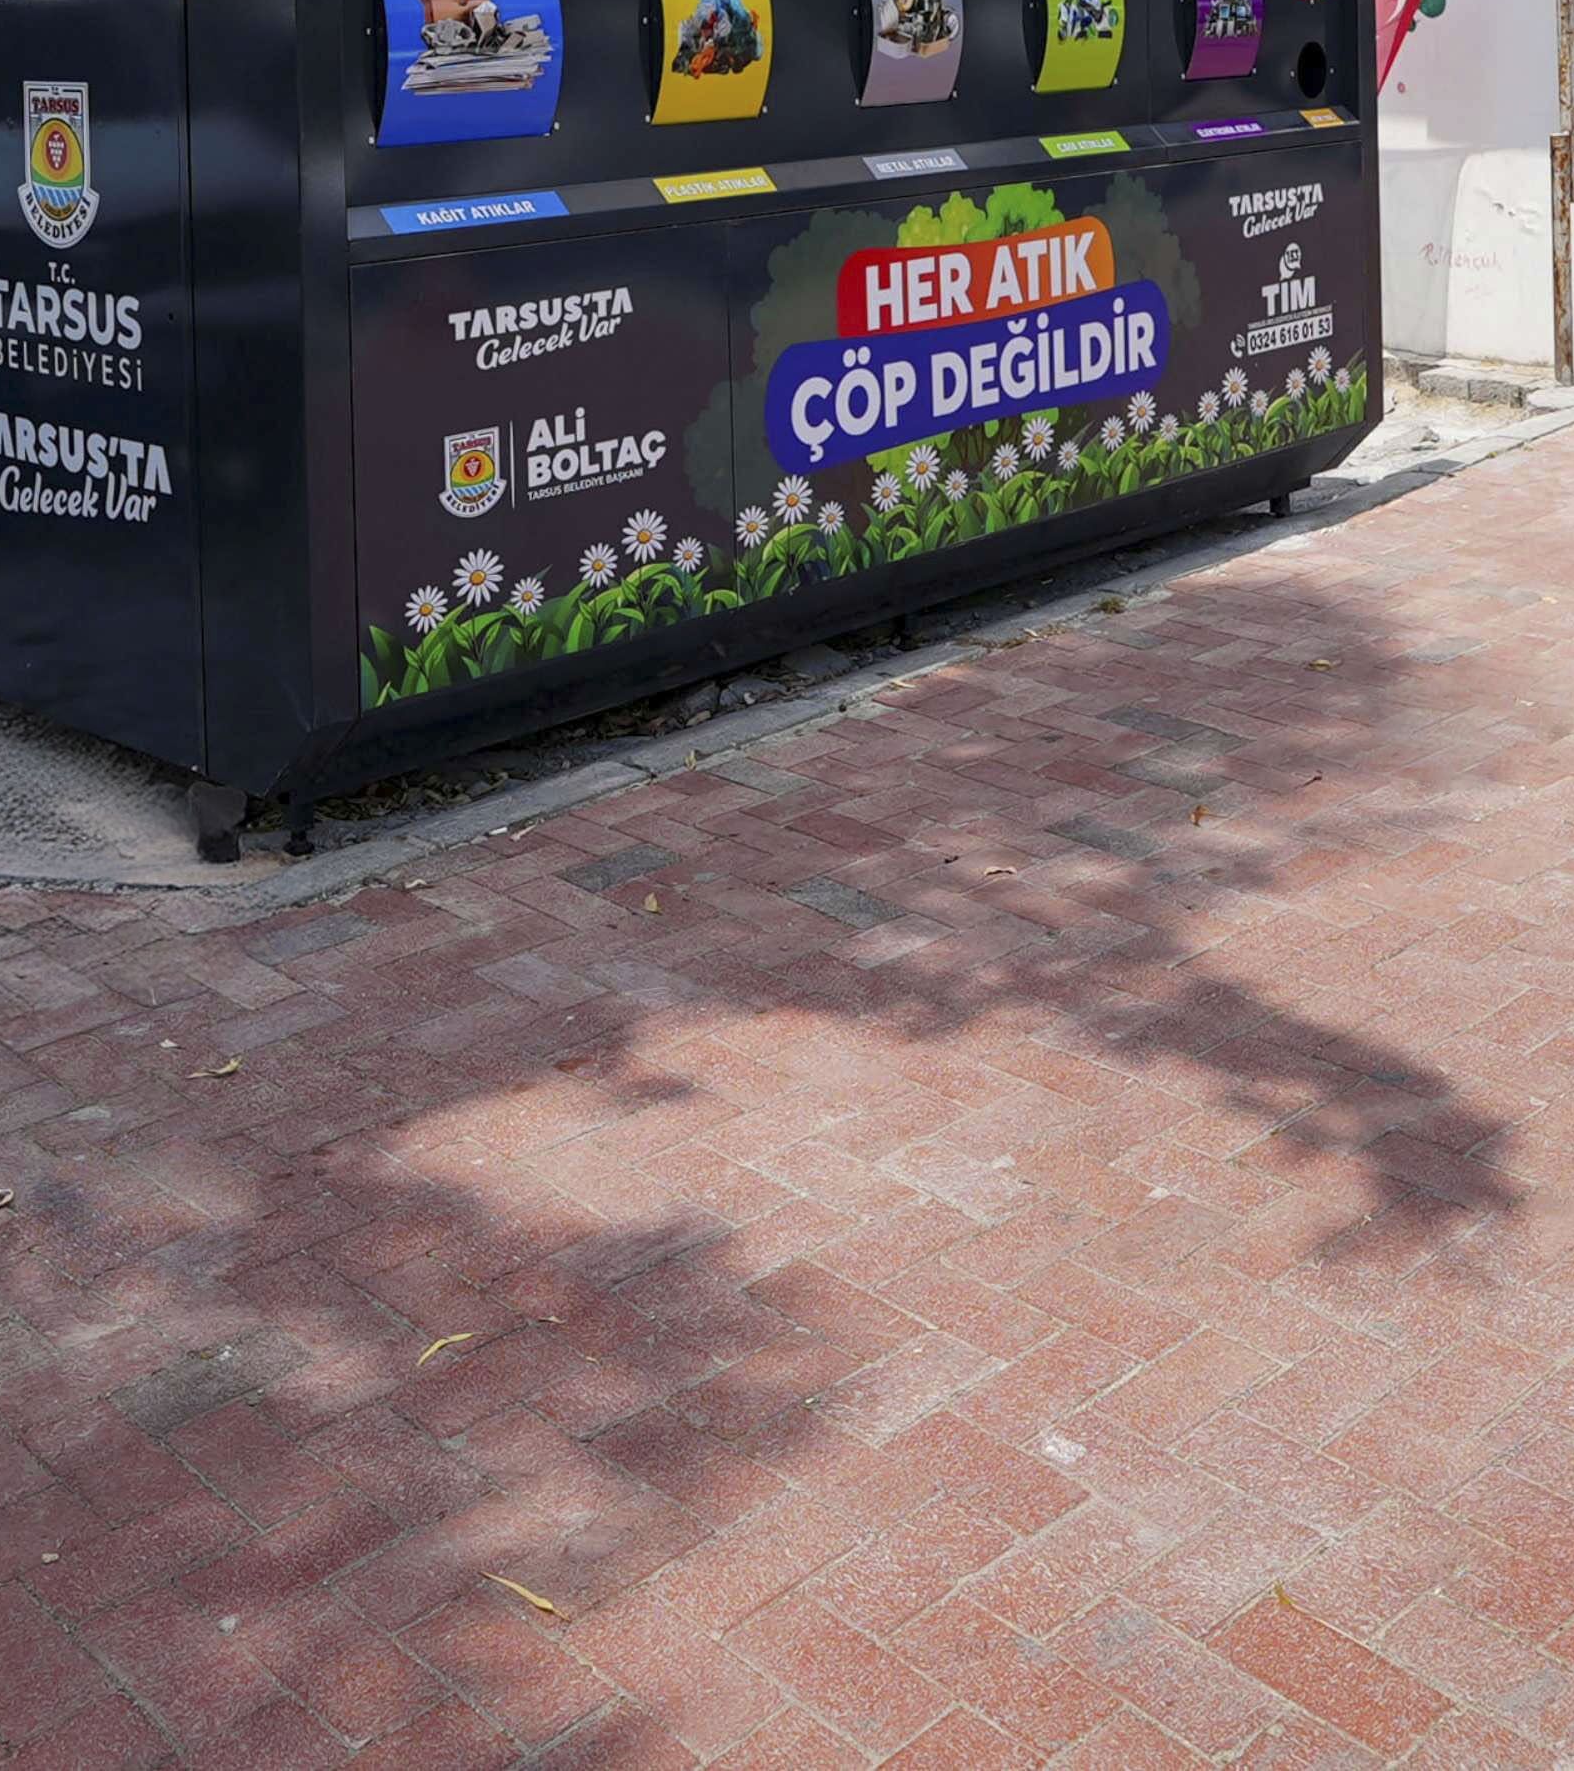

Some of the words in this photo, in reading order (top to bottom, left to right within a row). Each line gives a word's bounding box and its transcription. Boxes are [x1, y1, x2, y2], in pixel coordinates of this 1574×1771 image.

[31, 97, 80, 115] TARSUS
[718, 175, 768, 191] ATIKLAR
[1229, 183, 1324, 217] TARSUS'TA
[417, 207, 466, 226] KAĞIT
[470, 200, 536, 220] ATIKLAR
[1243, 208, 1292, 238] Gelecek
[1295, 201, 1318, 222] Var
[49, 262, 75, 284] T.C.
[865, 251, 973, 332] HER
[986, 231, 1097, 310] ATIK
[448, 287, 633, 341] TARSUS'TA
[476, 322, 574, 370] Gelecek
[578, 313, 621, 342] Var
[1250, 330, 1276, 351] 0324
[1279, 325, 1300, 345] 616
[1302, 321, 1314, 339] 01
[1319, 317, 1331, 335] 53
[790, 346, 917, 463] ÇÖP
[930, 297, 1157, 418] DEĞİLDİR
[526, 406, 586, 453] ALİ
[528, 430, 667, 488] BOLTAÇ
[106, 471, 157, 522] Var
[527, 485, 562, 501] TARSUS
[564, 477, 605, 494] BELEDİYE
[606, 468, 644, 484] BAŞKANI
